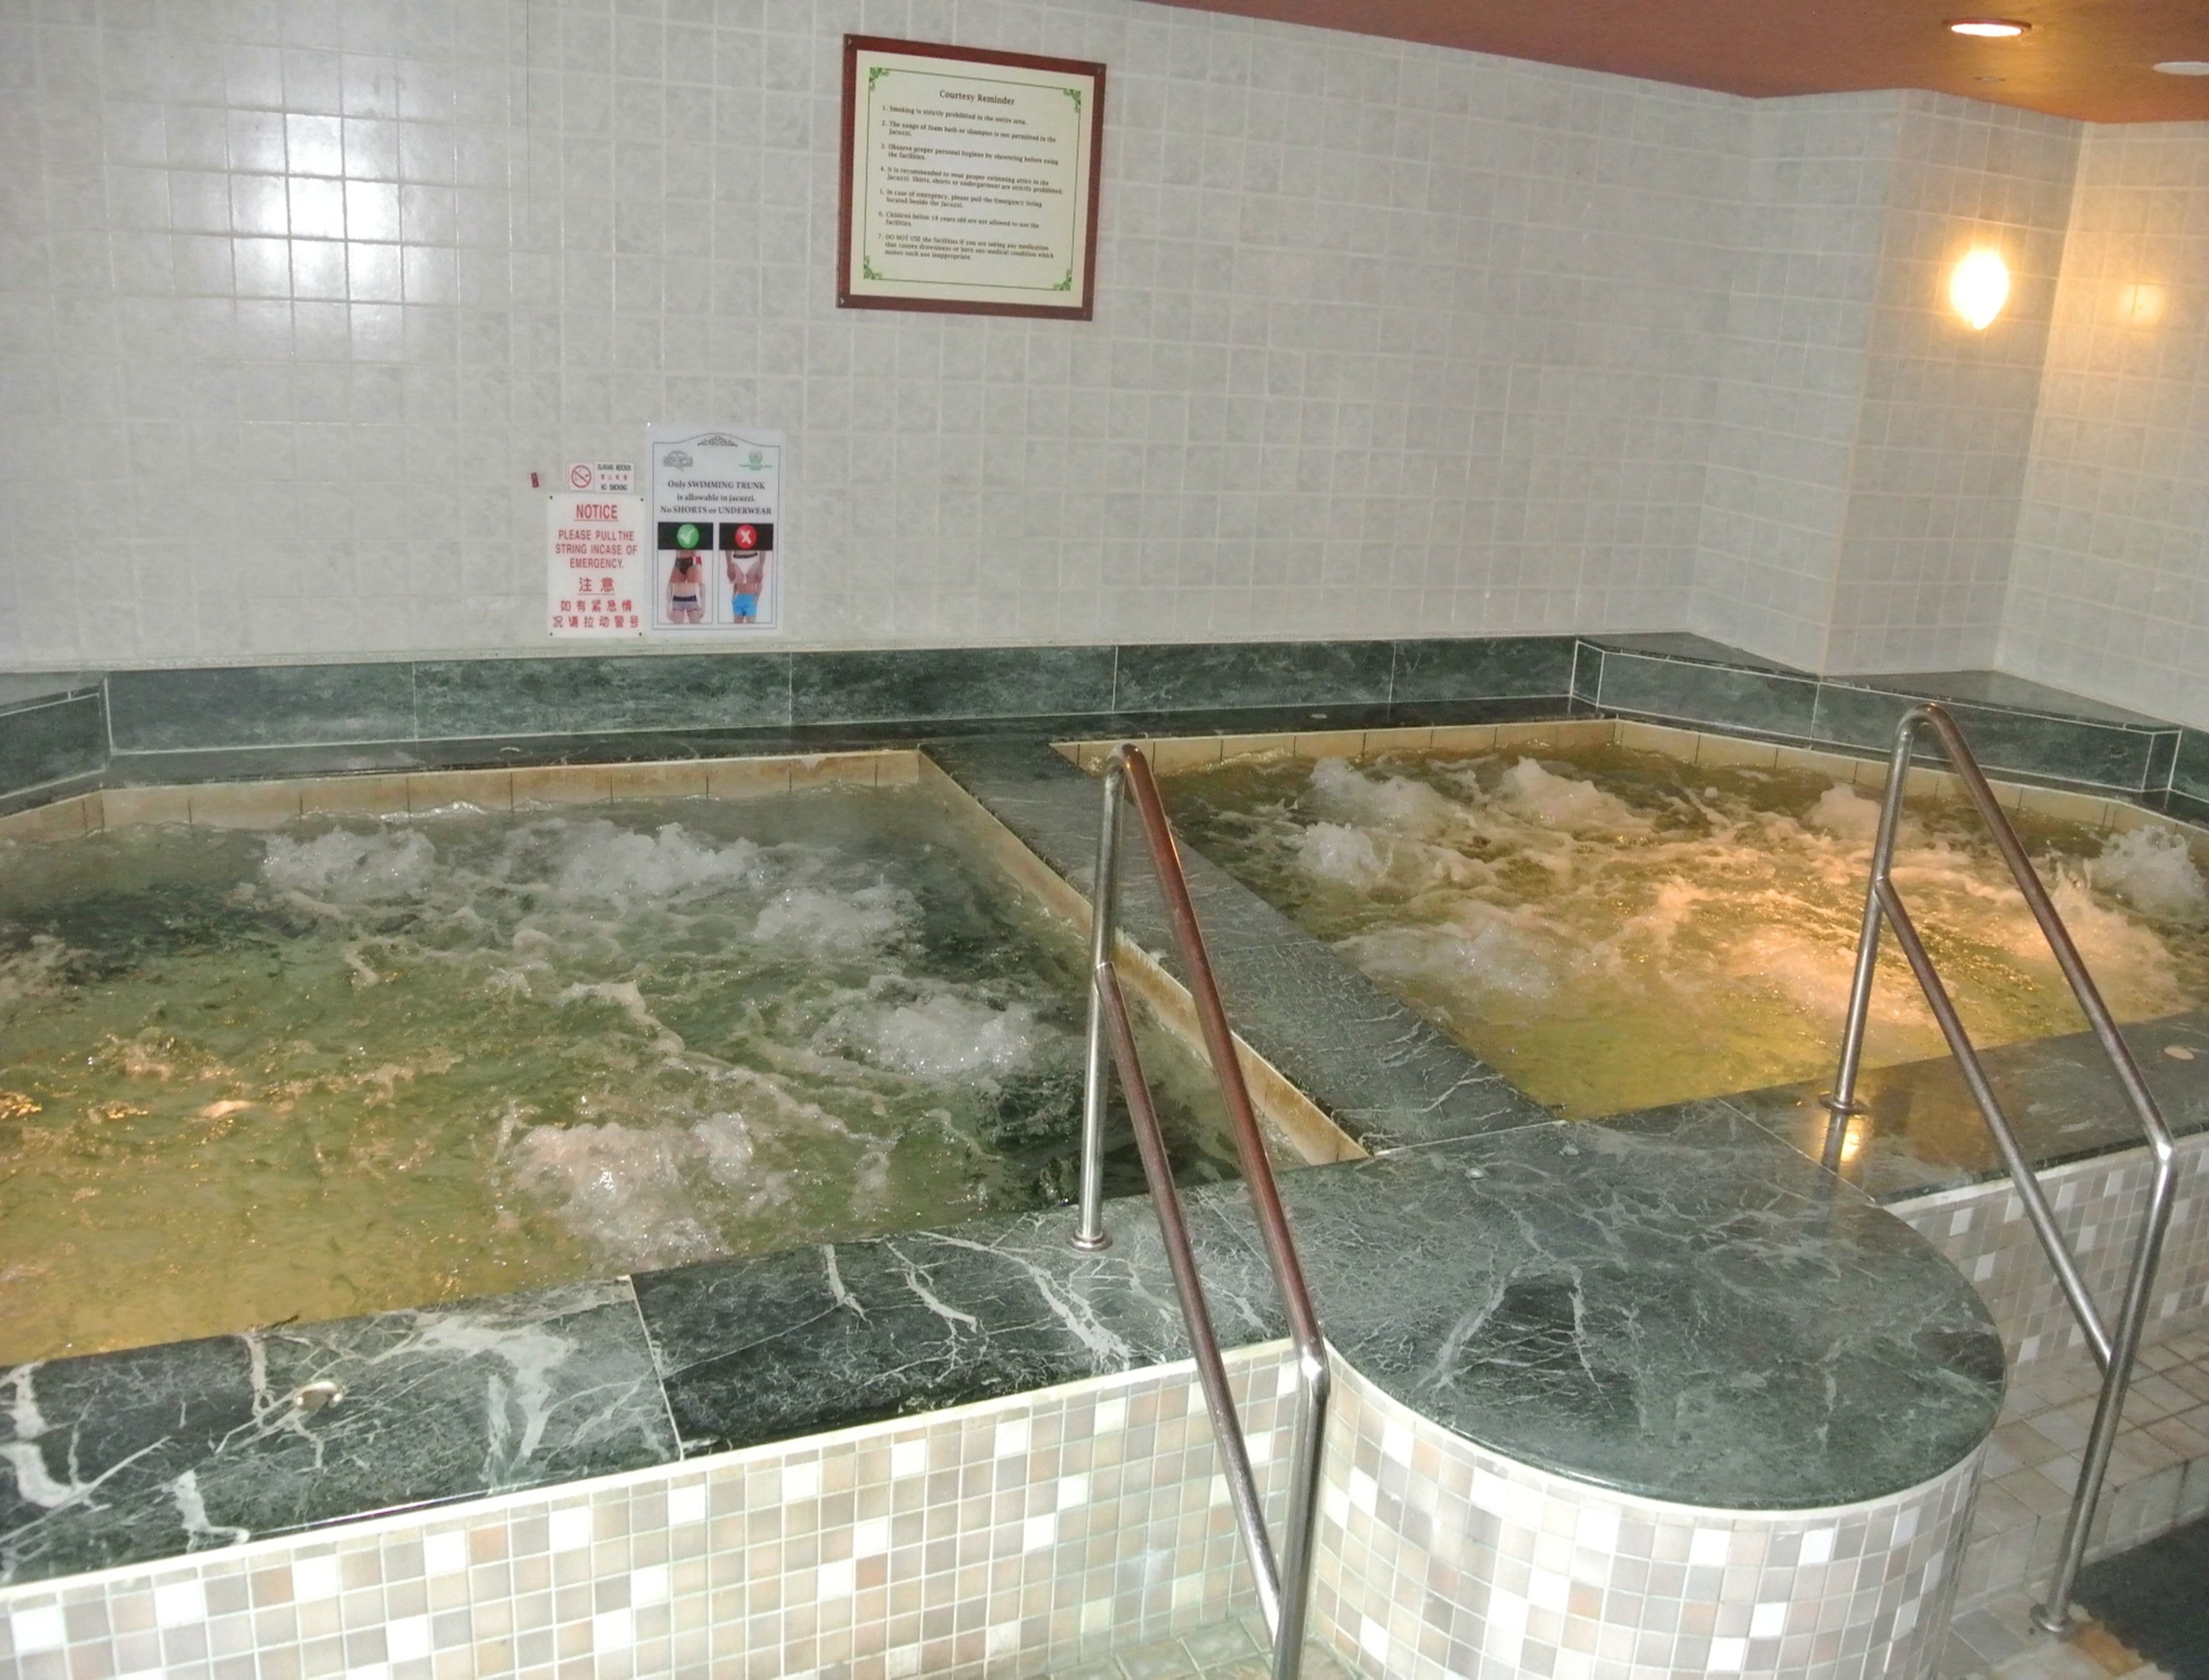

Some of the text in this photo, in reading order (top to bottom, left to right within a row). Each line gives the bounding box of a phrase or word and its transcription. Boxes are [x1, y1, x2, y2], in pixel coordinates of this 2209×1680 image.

[939, 90, 1015, 105] Courtesy Reminder
[889, 106, 914, 114] Smoking
[923, 109, 943, 117] strictly
[945, 112, 976, 120] prohibited
[967, 128, 992, 136] shampoo
[1012, 133, 1039, 141] permitted
[995, 153, 1023, 162] showering
[901, 169, 942, 177] recommended
[916, 192, 949, 200] emergency,
[994, 198, 1024, 206] Emergency
[1025, 200, 1042, 208] String
[668, 480, 686, 490] Only
[688, 480, 734, 489] SWIMMING
[685, 493, 719, 502] allowable
[729, 495, 756, 503] jacuzzi.
[576, 504, 618, 519] NOTICE
[719, 506, 772, 515] UNDERWEAR
[559, 530, 634, 541] PLEASE PULL THE
[555, 544, 637, 555] STRING INCASE OF
[570, 558, 624, 568] EMERGENCY.
[579, 577, 614, 592] 注意
[561, 600, 632, 612] 如有紧急情
